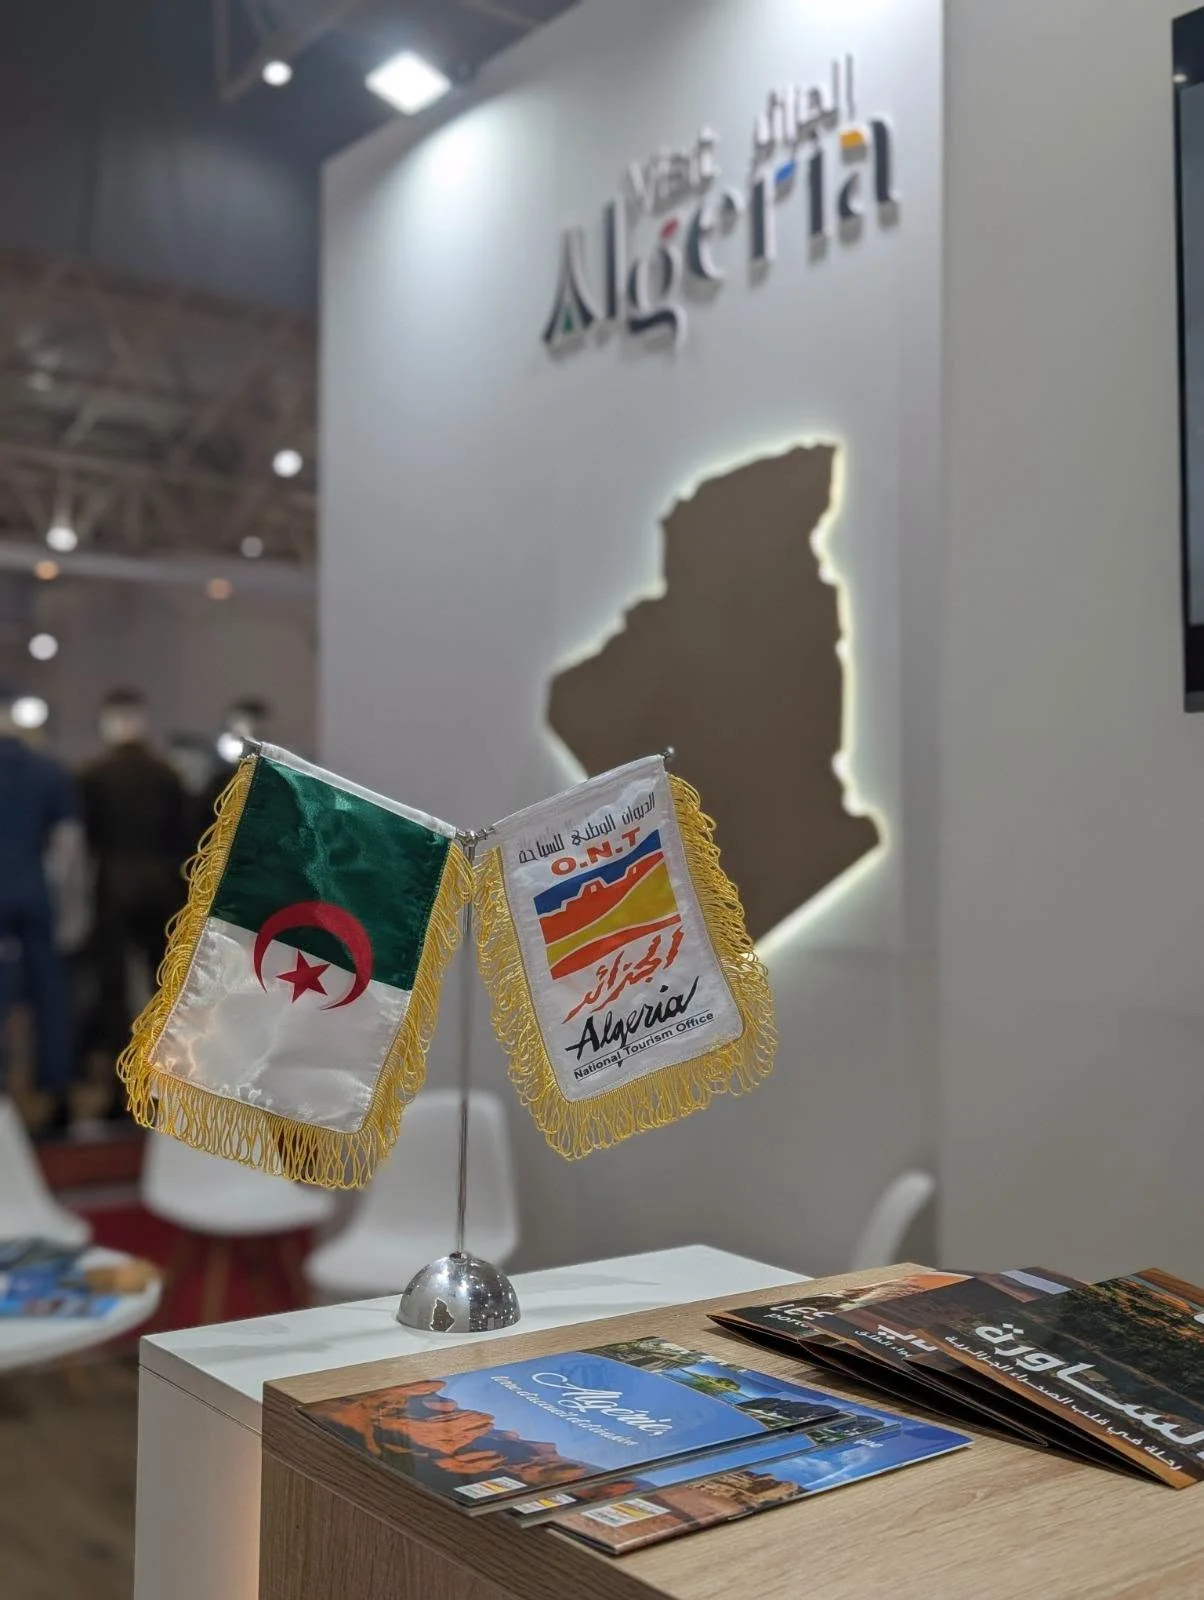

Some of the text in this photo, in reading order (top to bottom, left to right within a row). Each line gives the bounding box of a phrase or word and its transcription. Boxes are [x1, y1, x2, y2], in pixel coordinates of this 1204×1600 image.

[541, 115, 898, 347] Algeria
[518, 791, 655, 864] الديوان الوطني للسياحة
[551, 826, 641, 876] O.N.T
[561, 925, 685, 1025] الجزائر
[564, 975, 699, 1068] Algeria
[573, 1011, 715, 1081] National Tourism Office
[944, 1335, 1014, 1373] الجزائرية
[1010, 1371, 1074, 1406] الصحراء
[1071, 1403, 1110, 1426] قلب
[1144, 1444, 1184, 1471] رحلة
